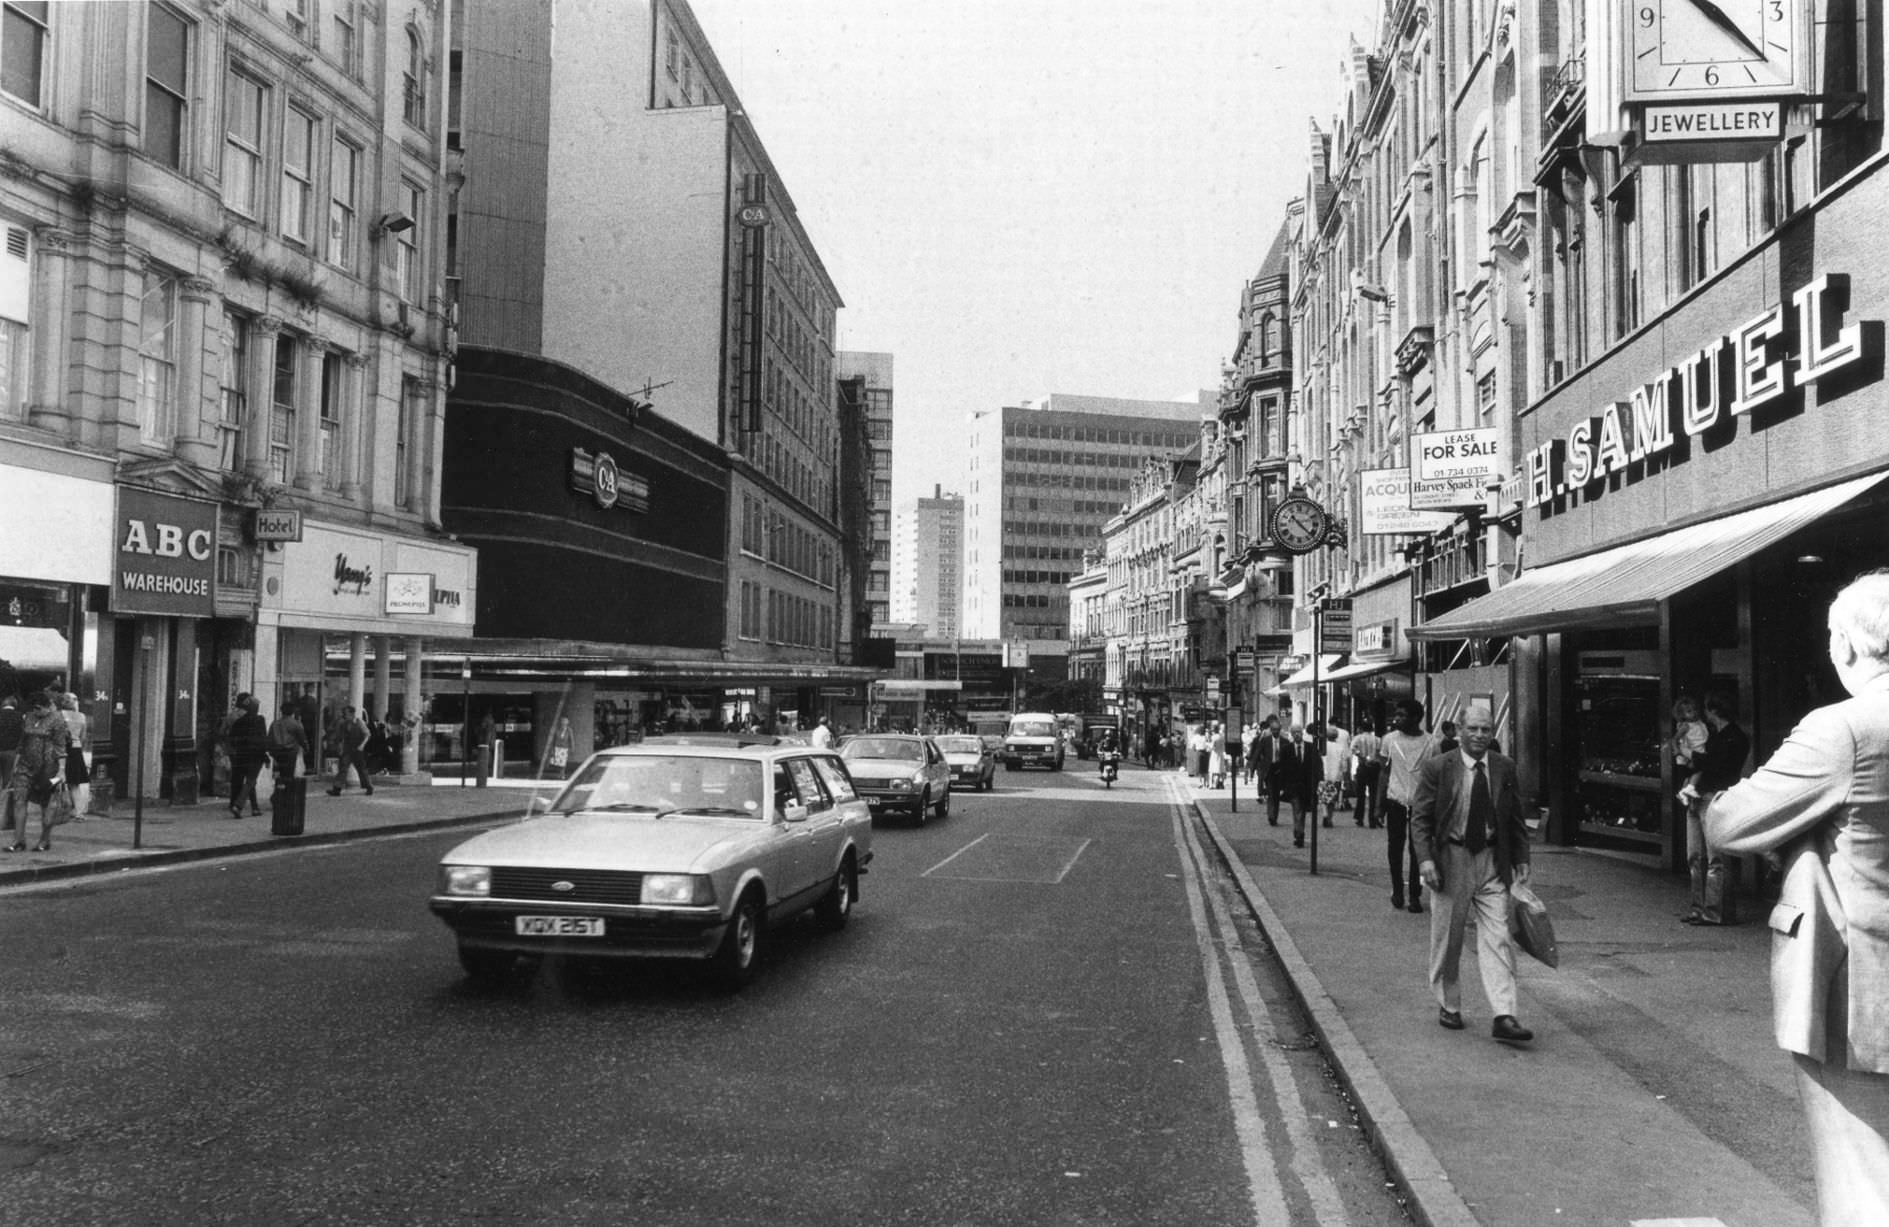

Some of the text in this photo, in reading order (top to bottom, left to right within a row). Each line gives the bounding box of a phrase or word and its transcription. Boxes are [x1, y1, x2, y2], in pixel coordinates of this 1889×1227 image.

[1640, 7, 1655, 28] 9
[1769, 1, 1783, 22] 3
[1705, 65, 1720, 86] 6
[1649, 111, 1775, 133] JEWELLERY
[1568, 273, 1863, 491] SAMUEL
[1445, 433, 1476, 444] LEASE
[1424, 441, 1497, 460] FOR SALE
[1366, 483, 1408, 496] ACQU
[1414, 481, 1446, 493] Harvey
[1447, 479, 1473, 492] Spack
[258, 518, 293, 533] Hotel
[122, 519, 211, 561] ABC
[122, 571, 208, 596] WAREHOUSE
